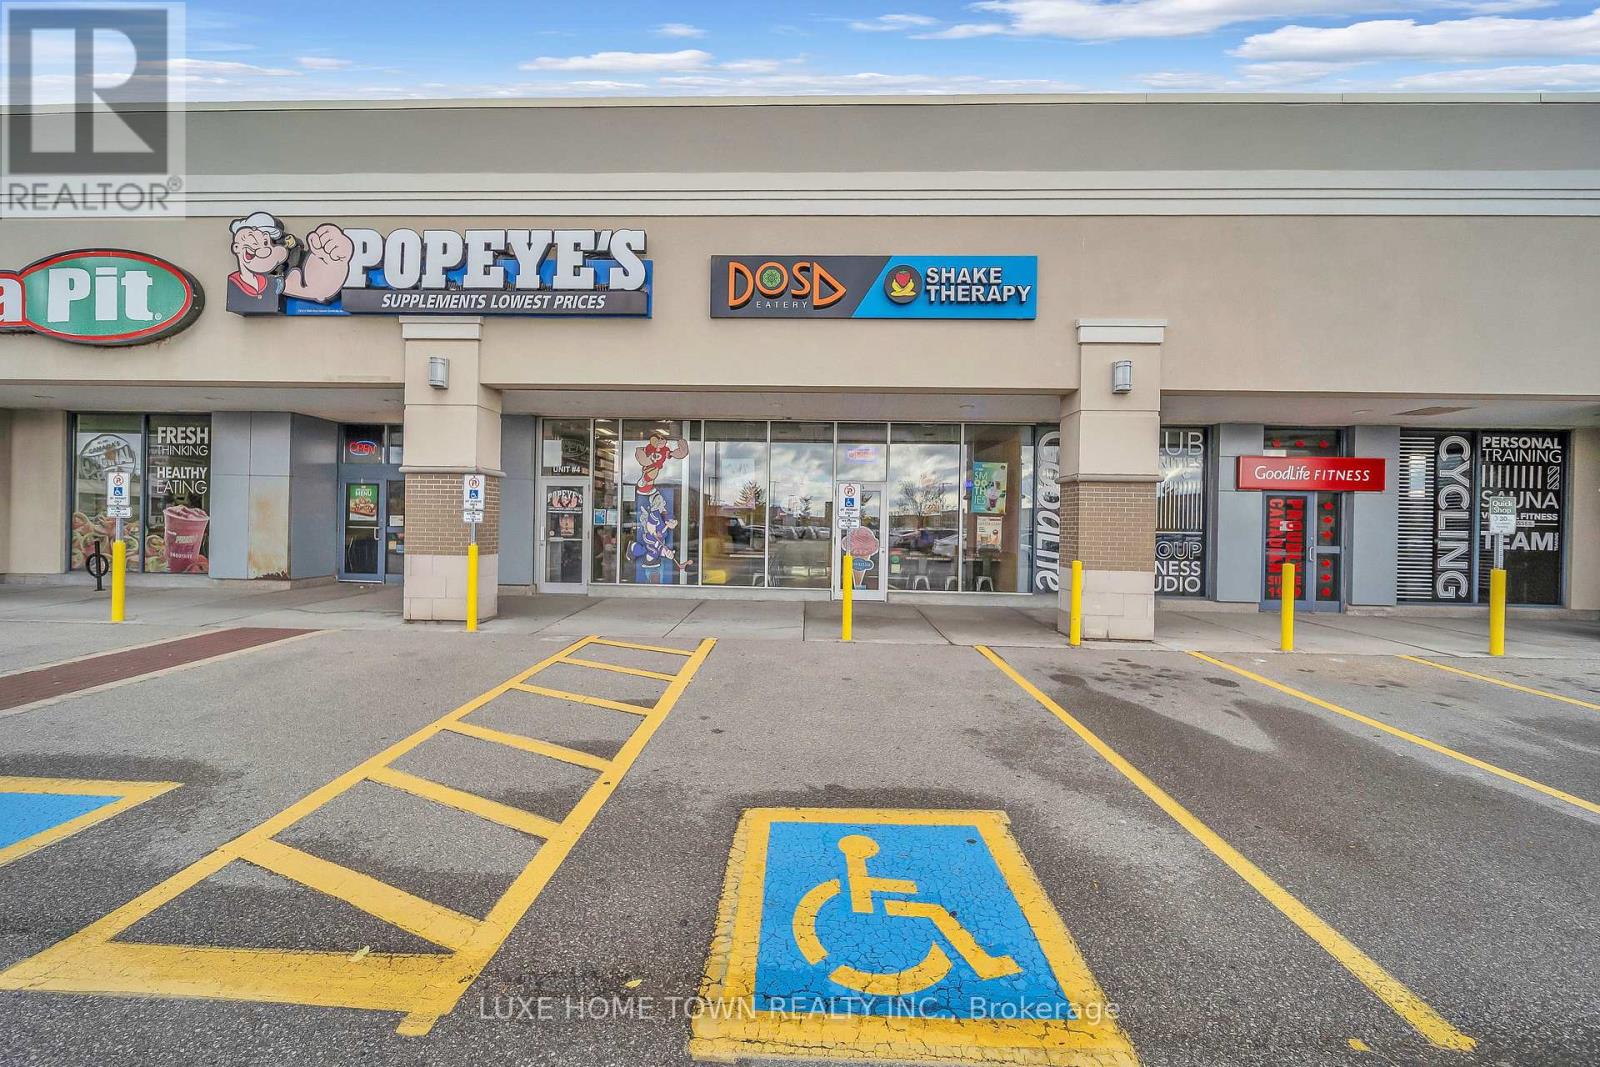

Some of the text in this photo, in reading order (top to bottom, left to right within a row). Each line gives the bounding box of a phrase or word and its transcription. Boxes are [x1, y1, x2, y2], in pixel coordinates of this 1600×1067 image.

[342, 228, 647, 291] POPEYE'S
[926, 267, 1002, 285] SHAKE
[381, 294, 605, 310] SUPPLEMENTS LOWEST PRICES
[926, 285, 1032, 303] THERAPY
[756, 301, 808, 309] EATERY
[157, 427, 209, 444] FRESH
[1482, 436, 1561, 449] PERSONAL
[158, 445, 208, 456] THINKING
[1160, 432, 1204, 456] UB
[1484, 449, 1561, 463] TRAINING
[157, 467, 207, 479] HEALTHY
[553, 465, 571, 473] UNIT
[1255, 465, 1370, 482] GoodLife FITNESS
[157, 480, 207, 494] EATING
[547, 489, 583, 504] POPEYE'S
[1492, 500, 1514, 508] Quick
[1436, 436, 1471, 599] CYCLING
[1520, 512, 1558, 521] FITNESS
[1156, 542, 1202, 559] OUP
[1155, 560, 1200, 576] NESS
[1154, 576, 1200, 593] UDIO
